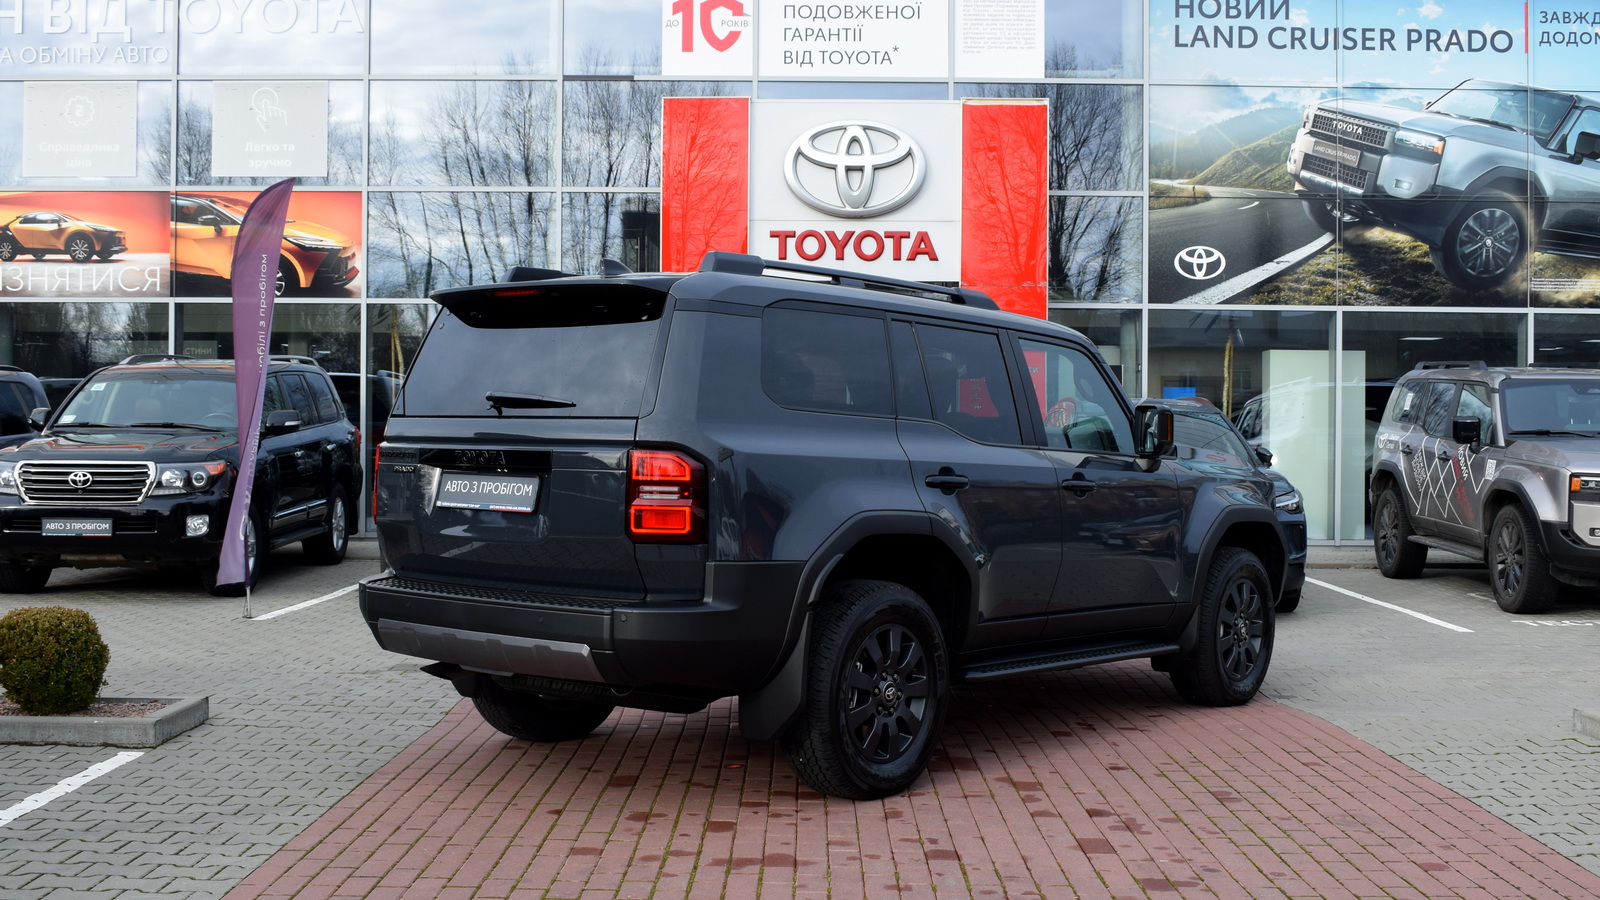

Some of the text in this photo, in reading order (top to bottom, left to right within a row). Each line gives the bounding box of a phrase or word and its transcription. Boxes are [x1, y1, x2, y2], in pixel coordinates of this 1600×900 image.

[784, 1, 923, 22] ПОДОВЖЕНОЇ
[42, 0, 132, 43] ВІД
[665, 19, 680, 28] ДО
[721, 19, 749, 28] РОКІВ
[784, 24, 864, 42] ГАРАНТІЇ
[1174, 25, 1514, 53] LAND CRUISER PRADO
[20, 46, 108, 64] ОБМІНУ
[114, 46, 169, 64] АВТО
[784, 50, 814, 68] ВІД
[1332, 120, 1362, 135] TOYOTA
[39, 141, 120, 153] Справедлива
[244, 141, 295, 152] Легко та
[66, 157, 92, 169] ціна
[248, 159, 292, 169] зручно
[769, 229, 940, 262] TOYOTA
[454, 450, 506, 465] TOYOTA
[444, 480, 533, 496] АВТО З ПРОБІГОМ
